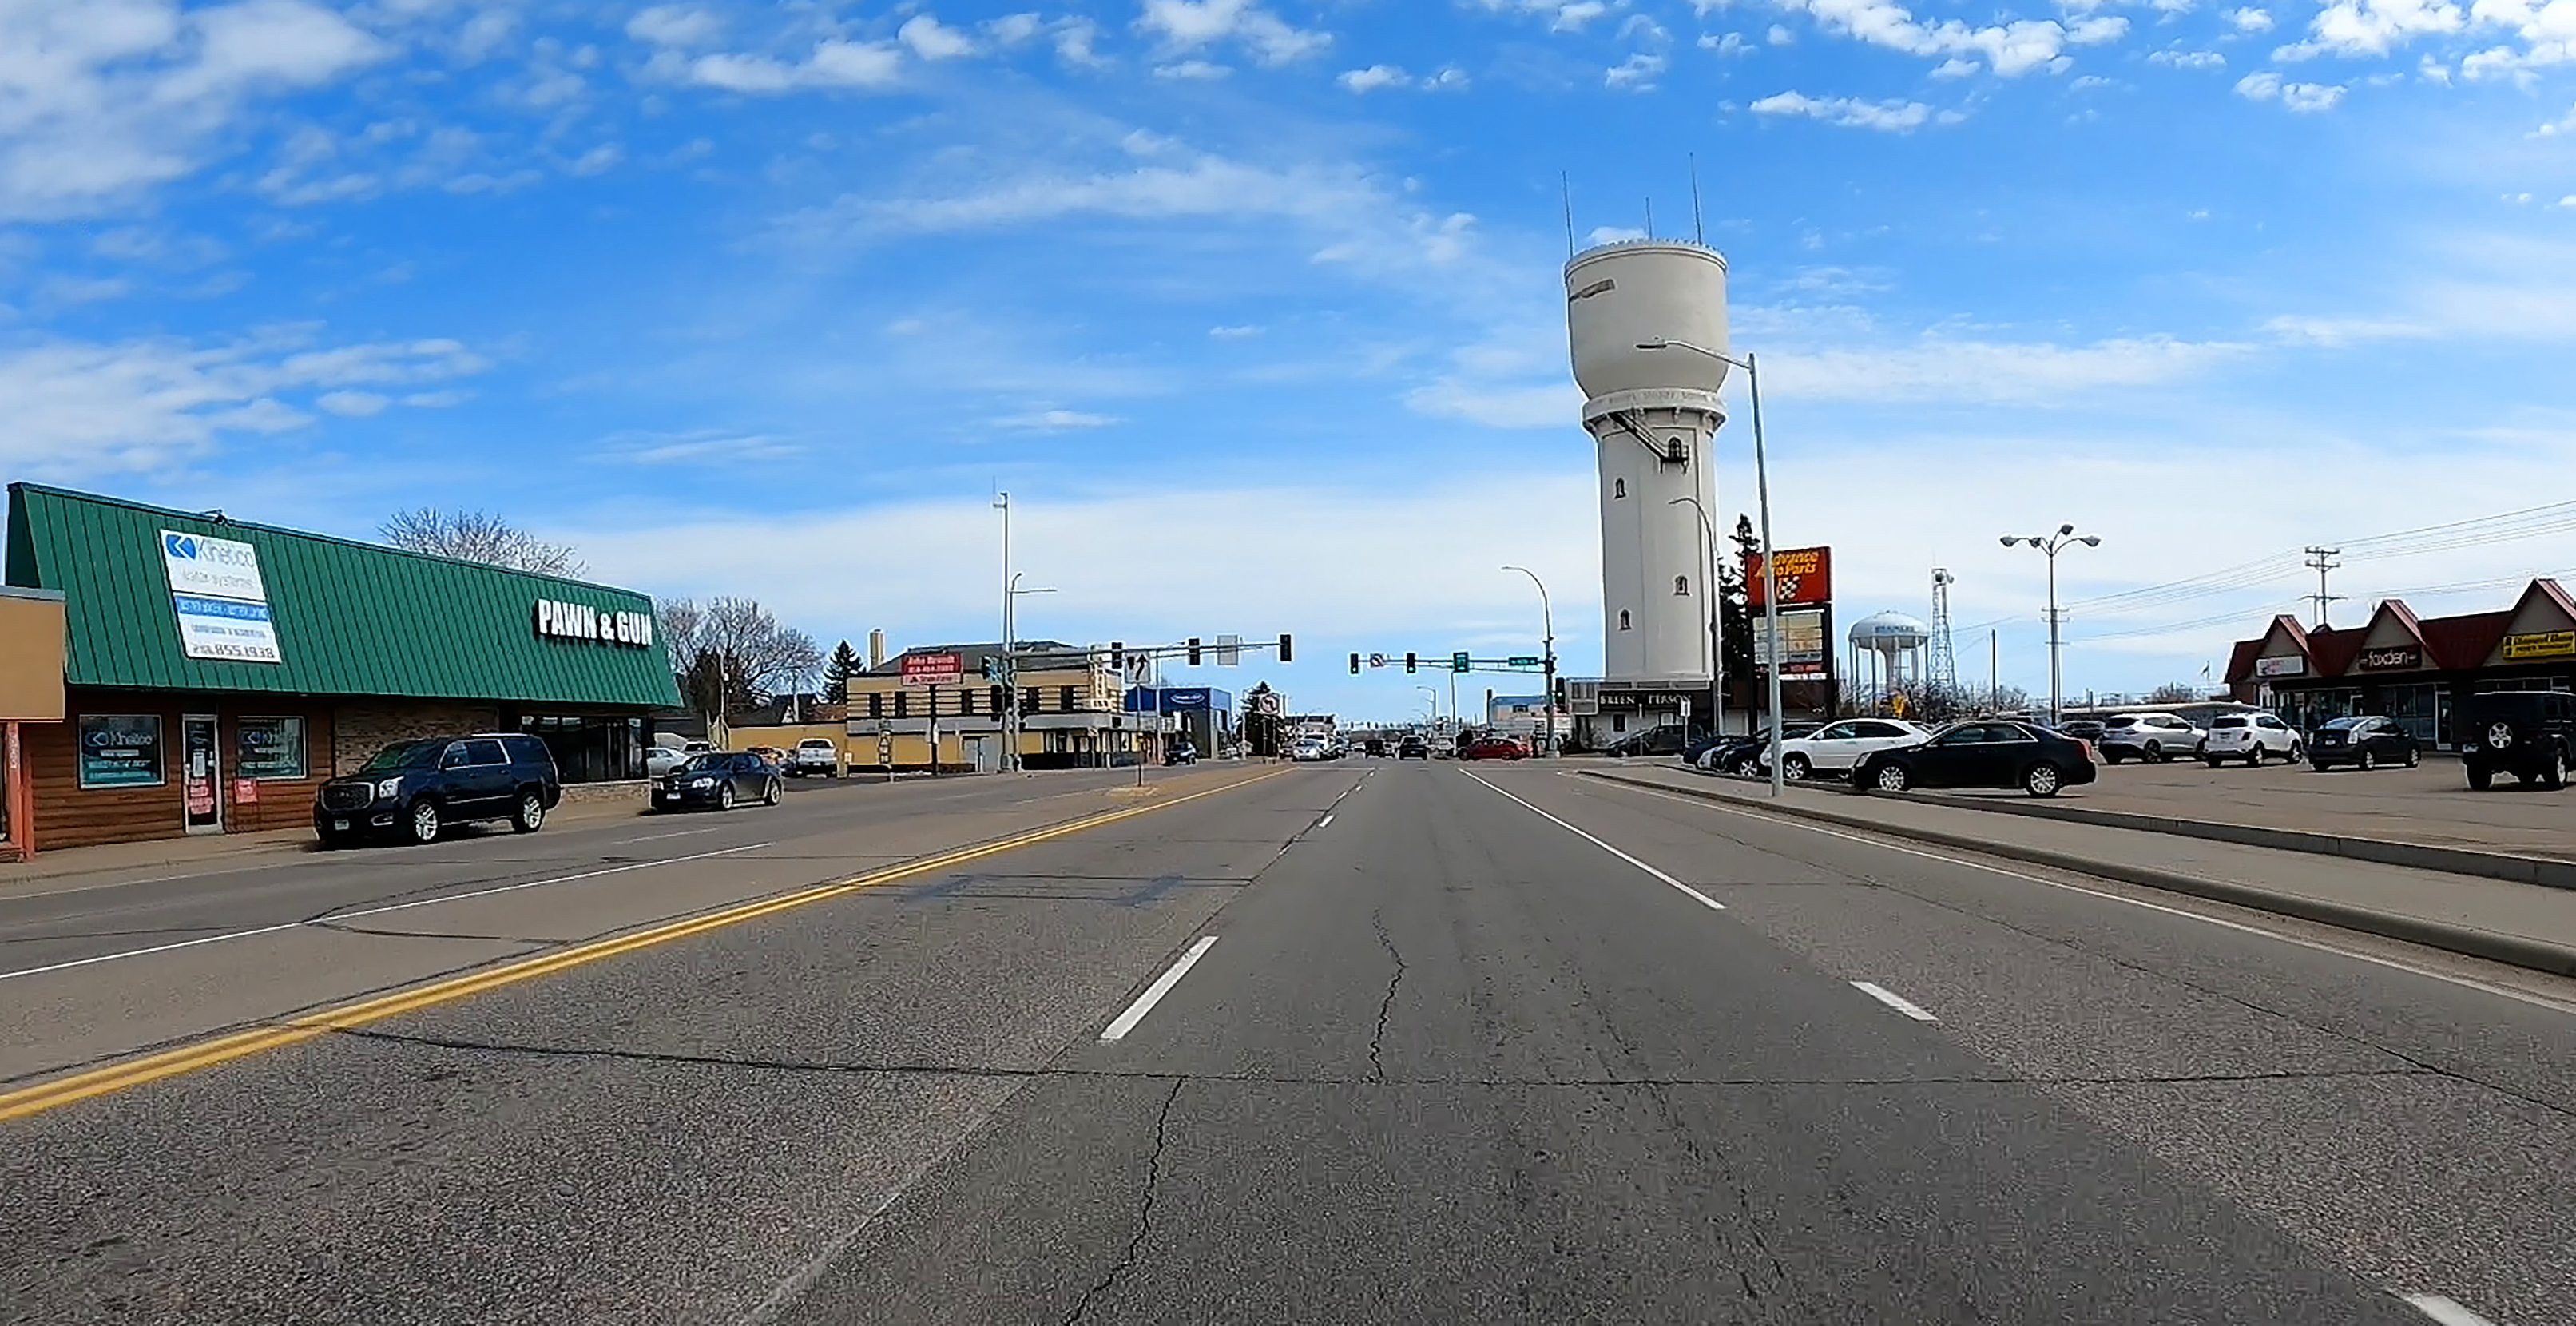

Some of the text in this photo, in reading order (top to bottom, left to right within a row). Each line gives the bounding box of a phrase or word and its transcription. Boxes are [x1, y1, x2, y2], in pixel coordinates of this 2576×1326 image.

[196, 538, 255, 567] Kinetico
[538, 599, 653, 645] PAWN & GUN
